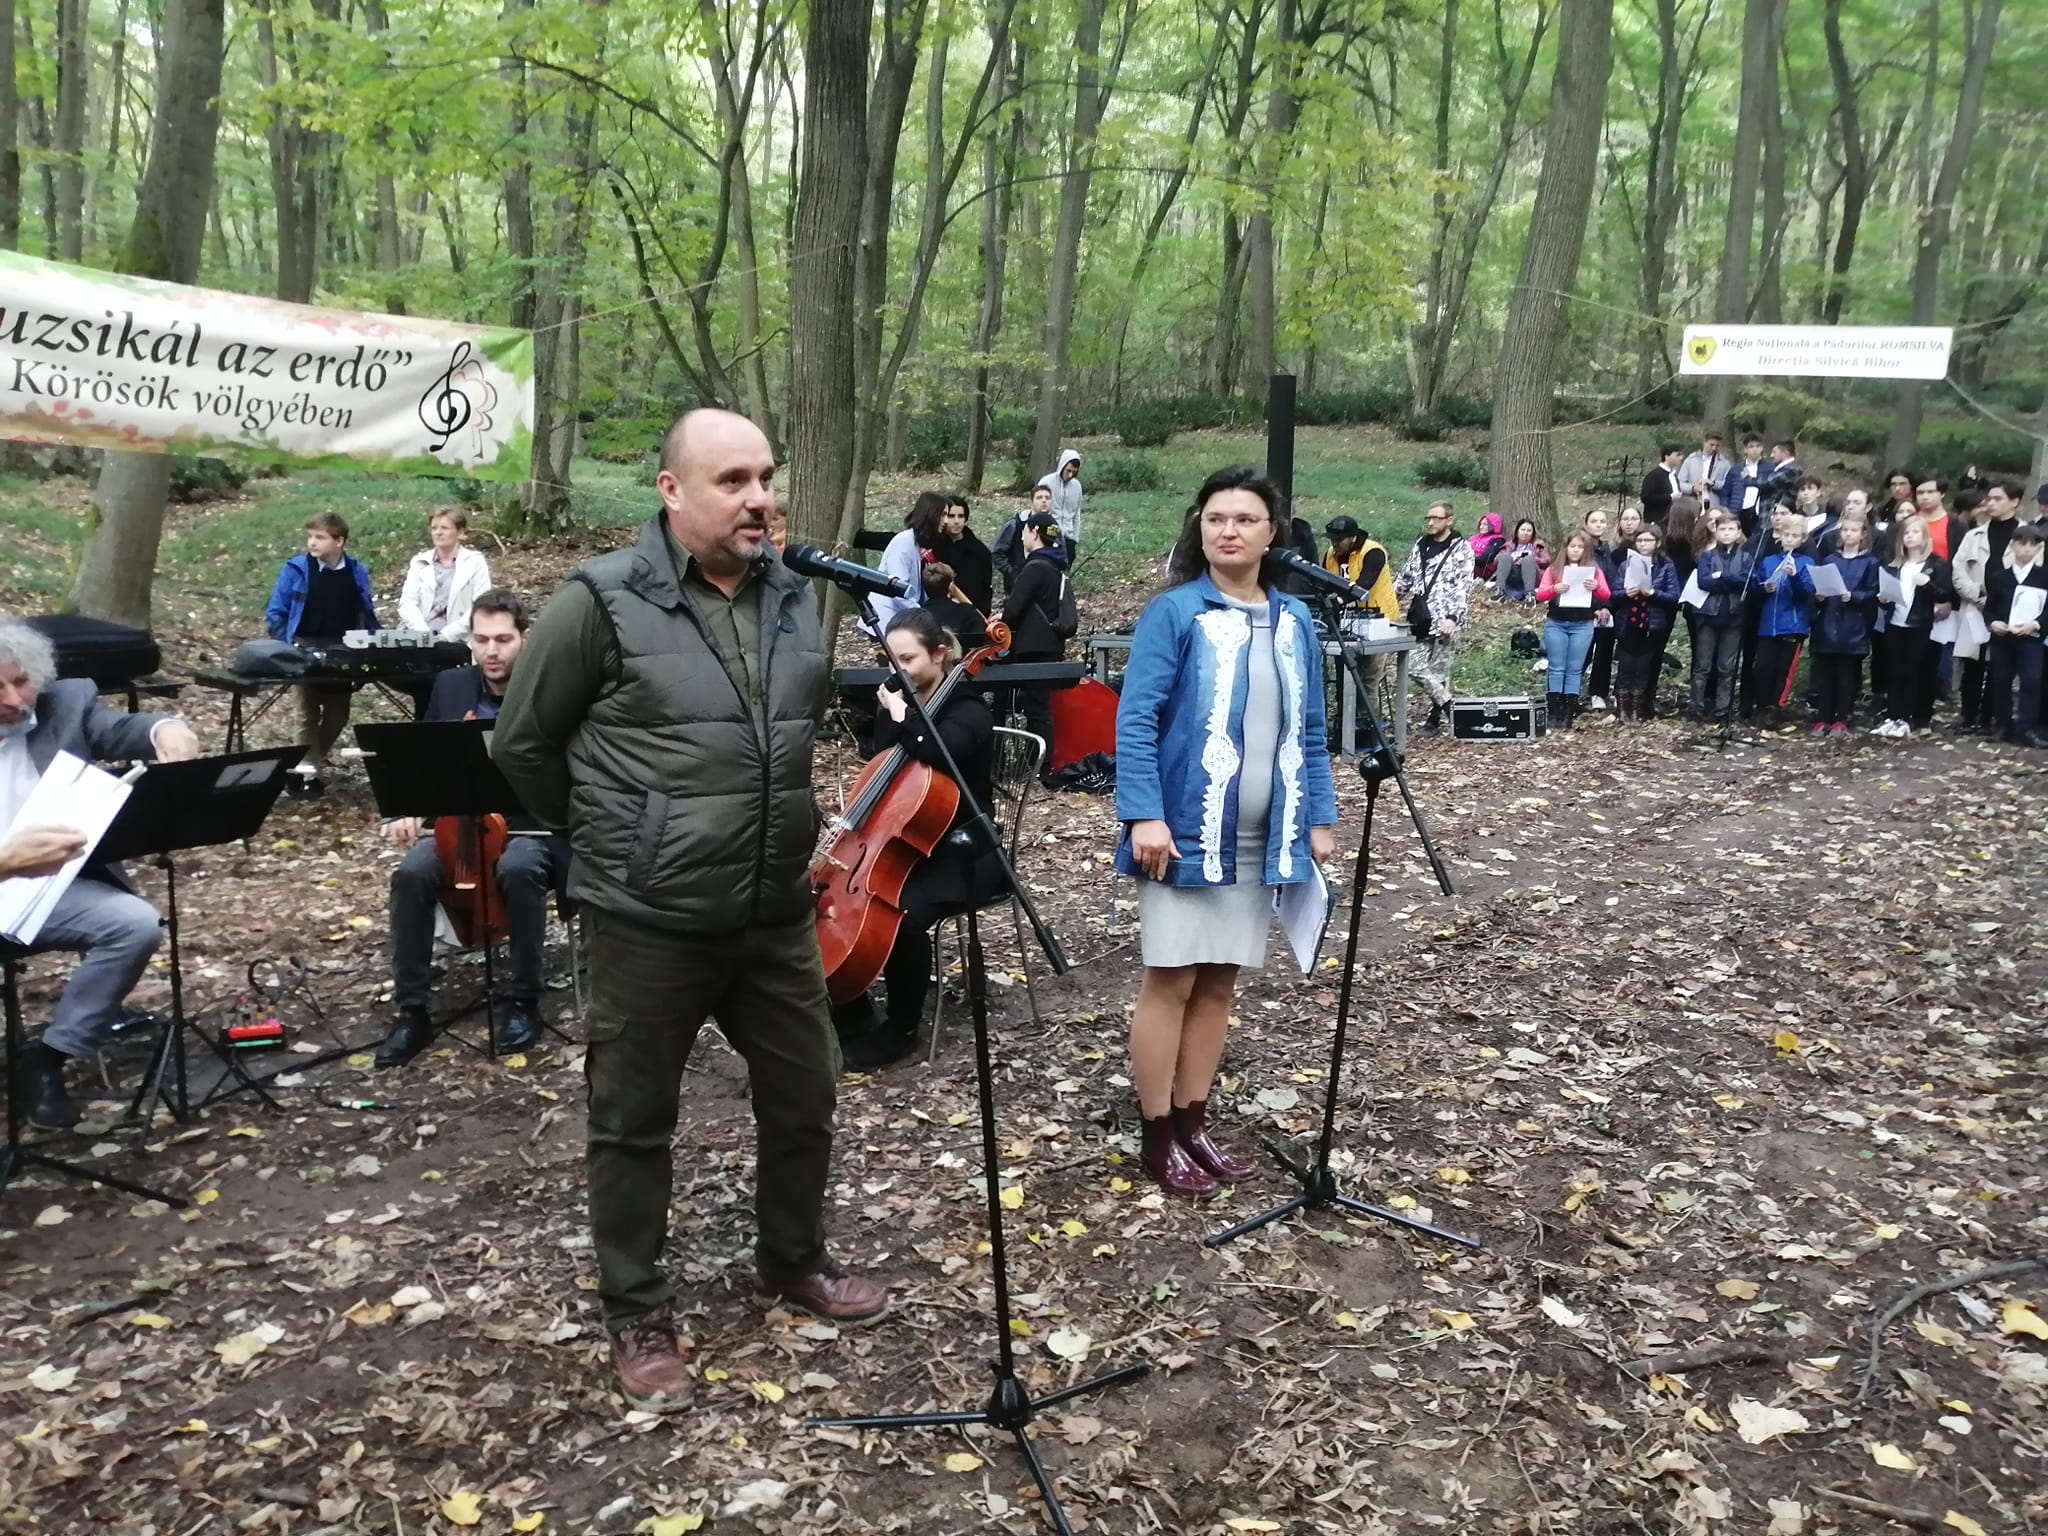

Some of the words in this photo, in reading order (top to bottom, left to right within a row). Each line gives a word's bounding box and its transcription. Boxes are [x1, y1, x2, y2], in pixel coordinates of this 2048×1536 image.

[1722, 338, 1753, 350] Regia
[1880, 340, 1944, 351] ROMSILVA
[217, 342, 278, 378] az
[1864, 357, 1901, 368] Bihor
[8, 358, 179, 411] Körösök
[192, 385, 353, 431] völgyében
